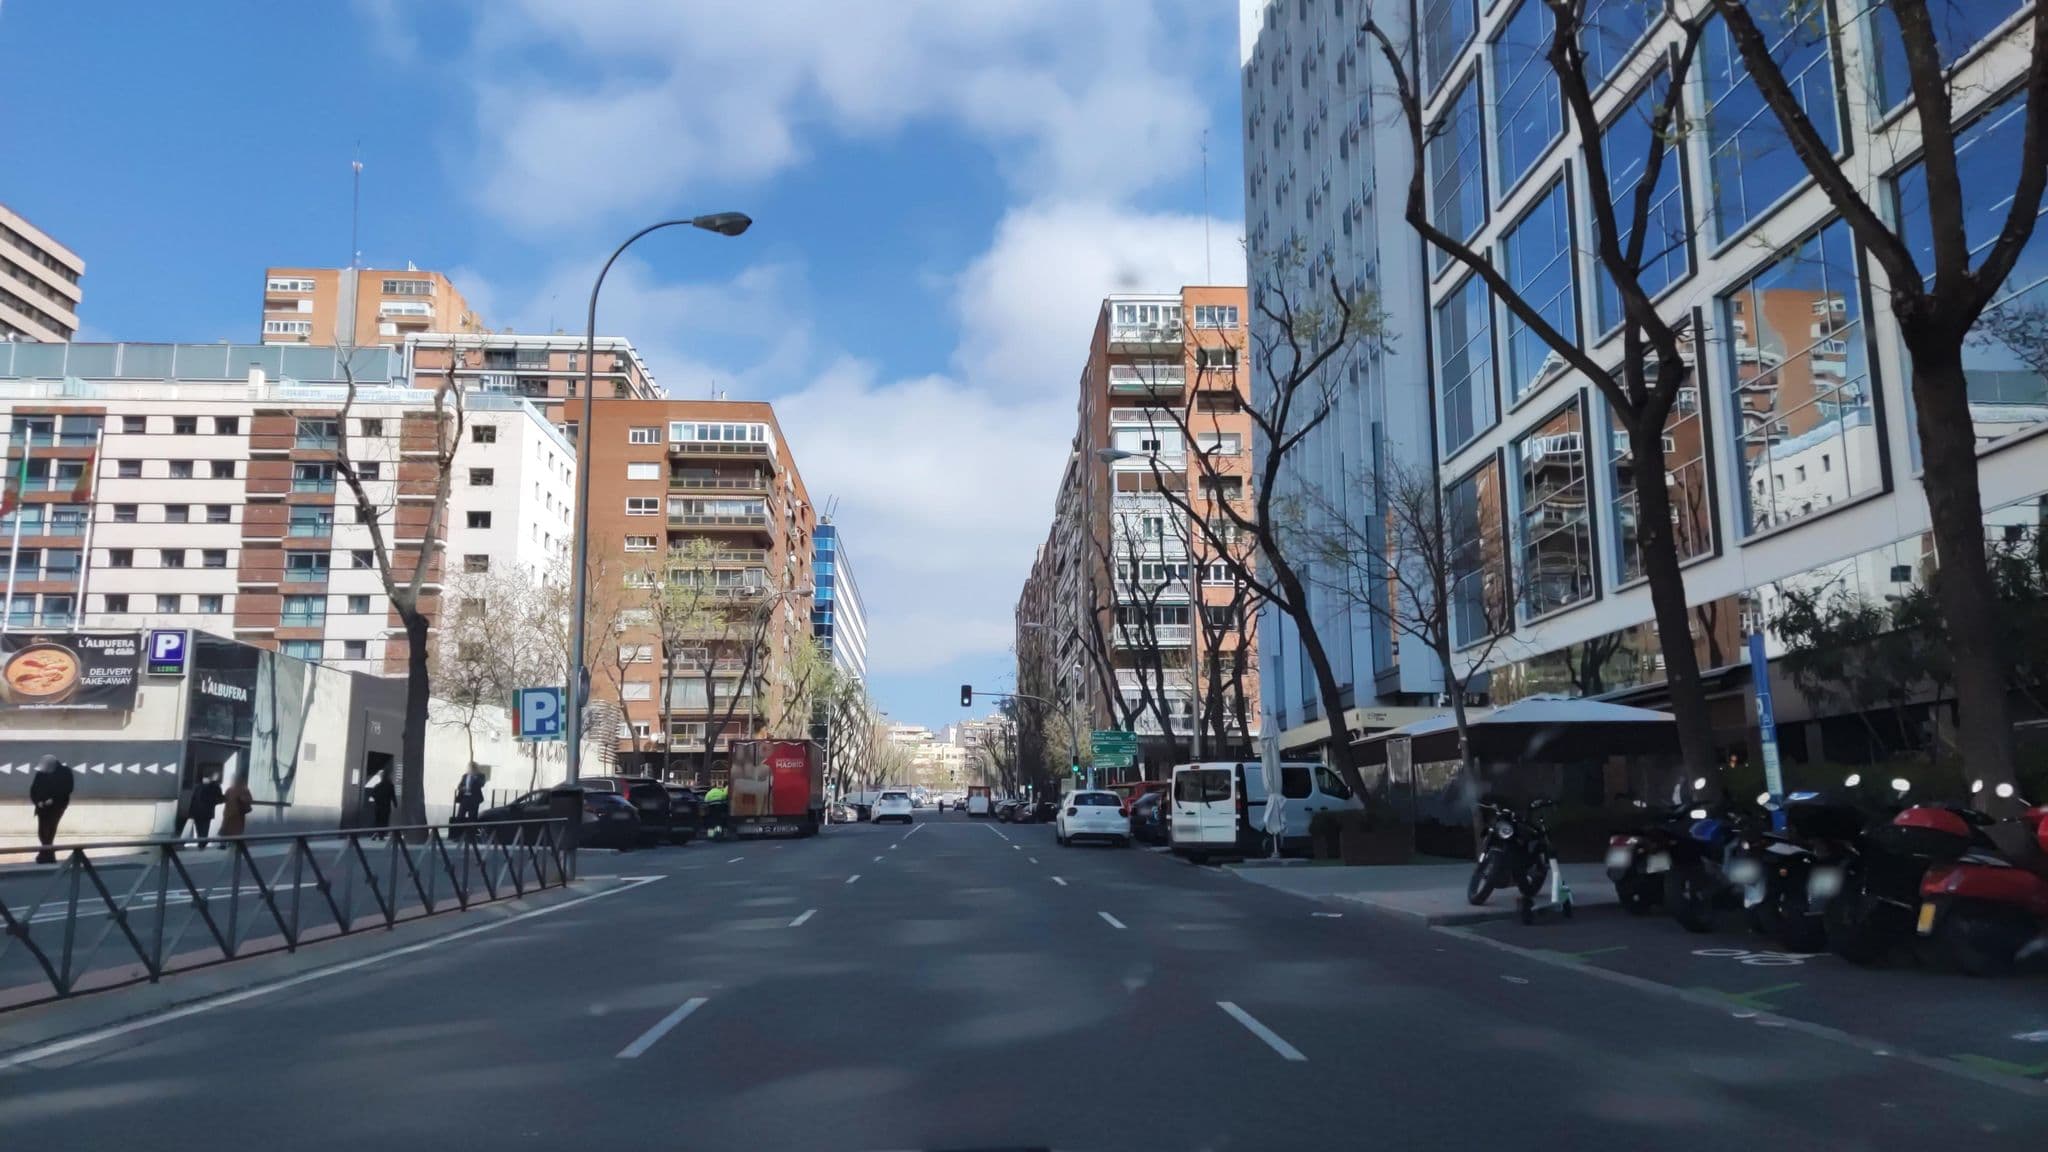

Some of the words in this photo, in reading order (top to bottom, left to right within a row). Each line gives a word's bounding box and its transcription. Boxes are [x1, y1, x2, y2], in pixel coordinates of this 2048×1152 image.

[78, 636, 135, 648] L'ALBUFERA
[155, 633, 180, 658] P
[89, 667, 133, 676] DELIVERY
[81, 677, 131, 685] TAKE-AWAY
[201, 676, 247, 702] L'ALBUFERA
[523, 692, 557, 732] P
[775, 759, 804, 769] MADRID
